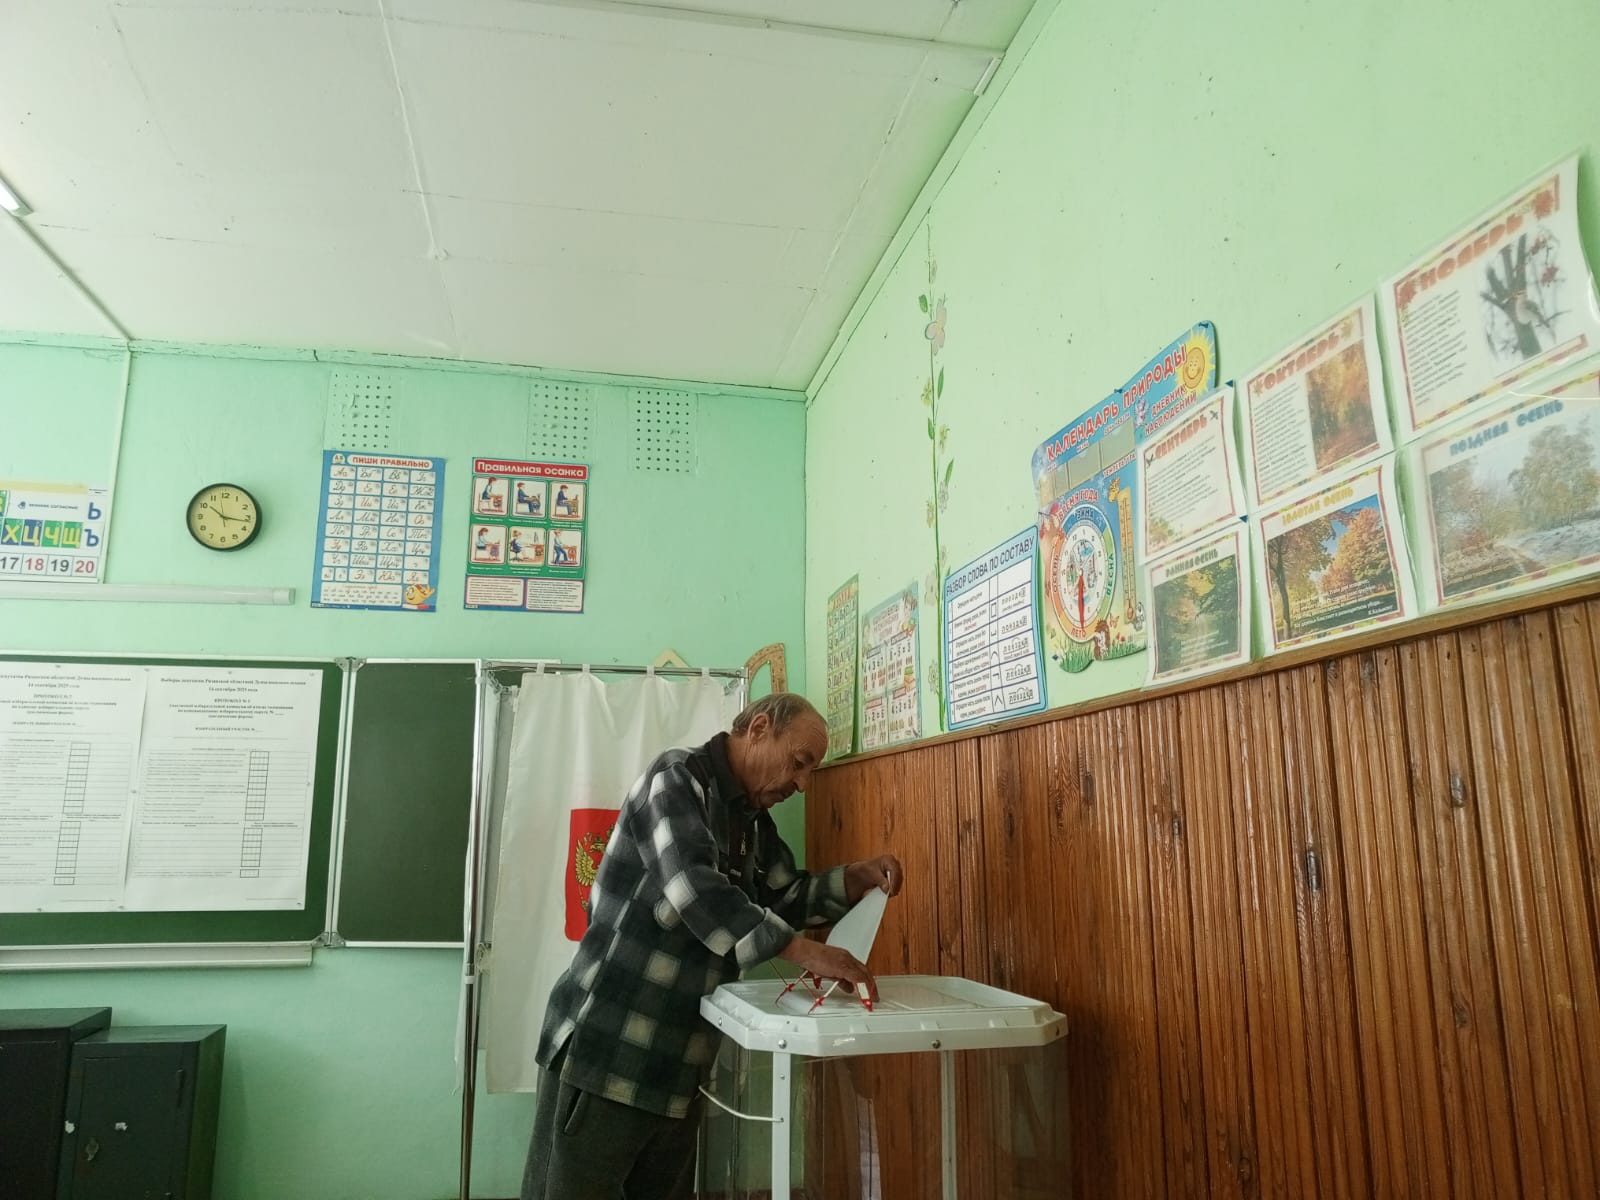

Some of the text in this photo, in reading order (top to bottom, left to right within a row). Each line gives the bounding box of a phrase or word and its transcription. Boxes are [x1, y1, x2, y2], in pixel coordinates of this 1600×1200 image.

[1419, 212, 1523, 291] НОЯБРЬ
[1263, 332, 1340, 390] ОКТЯБРЬ
[1046, 343, 1187, 460] КАЛЕНДАРЬ ПРИРОДЫ
[1145, 390, 1197, 434] НАБЛЮДЕНИЙ
[1152, 383, 1186, 417] ДНЕВНИК
[1155, 414, 1208, 460] СЕНТЯБРЬ
[1450, 400, 1563, 456] ПОЗДНЯЯ ОСЕНЬ
[352, 456, 430, 468] ПИШИ ПРАВИЛЬНО
[477, 461, 584, 477] Правильная осанка
[87, 502, 102, 520] Ь
[1058, 488, 1098, 520] ВРЕМЯ ГОДА
[1323, 487, 1354, 507] ОСЕНЬ
[3, 524, 20, 544] Х
[23, 525, 40, 546] Ц
[45, 526, 60, 546] Ч
[84, 529, 99, 547] Ъ
[0, 556, 95, 573] 17 18 19 20
[946, 535, 1035, 596] РАЗБОР СЛОВА ПО СОСТАВУ
[1194, 548, 1218, 566] ОСЕНЬ
[1071, 627, 1087, 638] ЛЕТО
